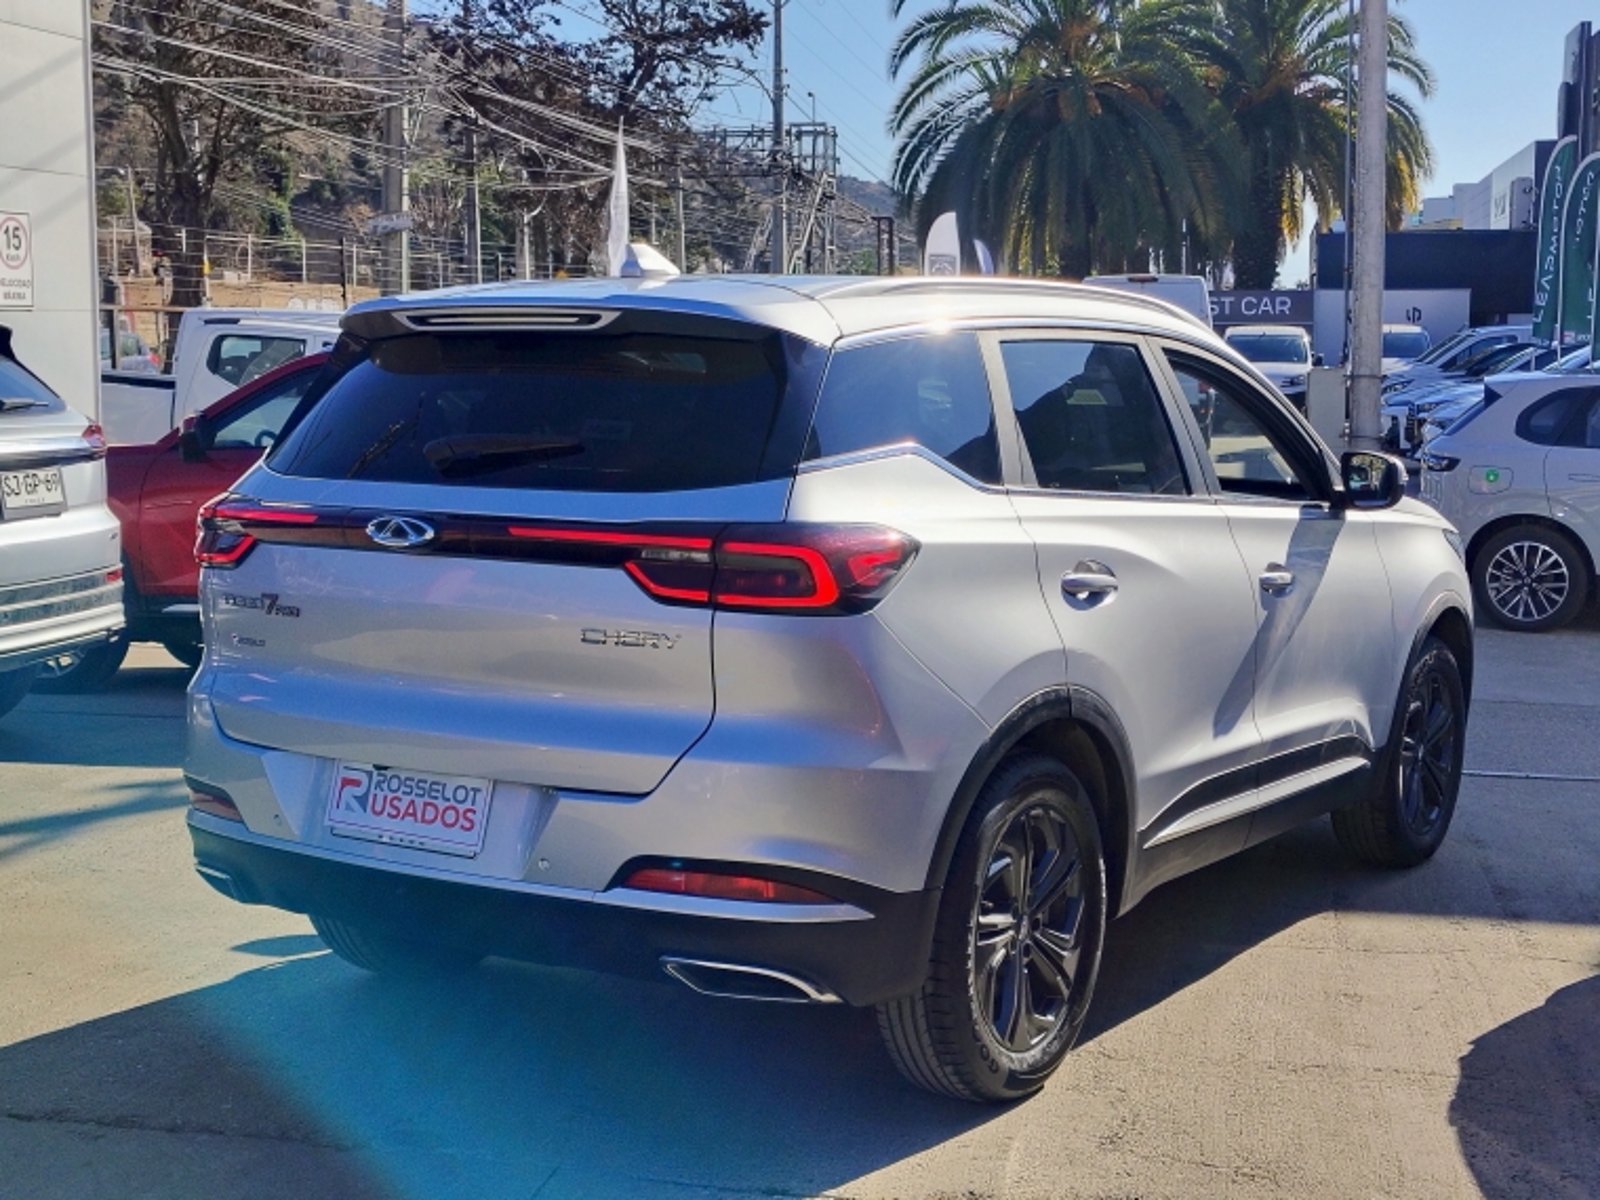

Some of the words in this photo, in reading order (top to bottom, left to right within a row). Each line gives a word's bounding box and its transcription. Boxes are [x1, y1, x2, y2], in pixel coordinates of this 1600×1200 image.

[3, 225, 22, 251] 15
[1241, 295, 1292, 316] CAR
[580, 627, 682, 650] CHERY
[374, 772, 482, 807] ROSSELOT
[370, 793, 477, 832] USADOS
